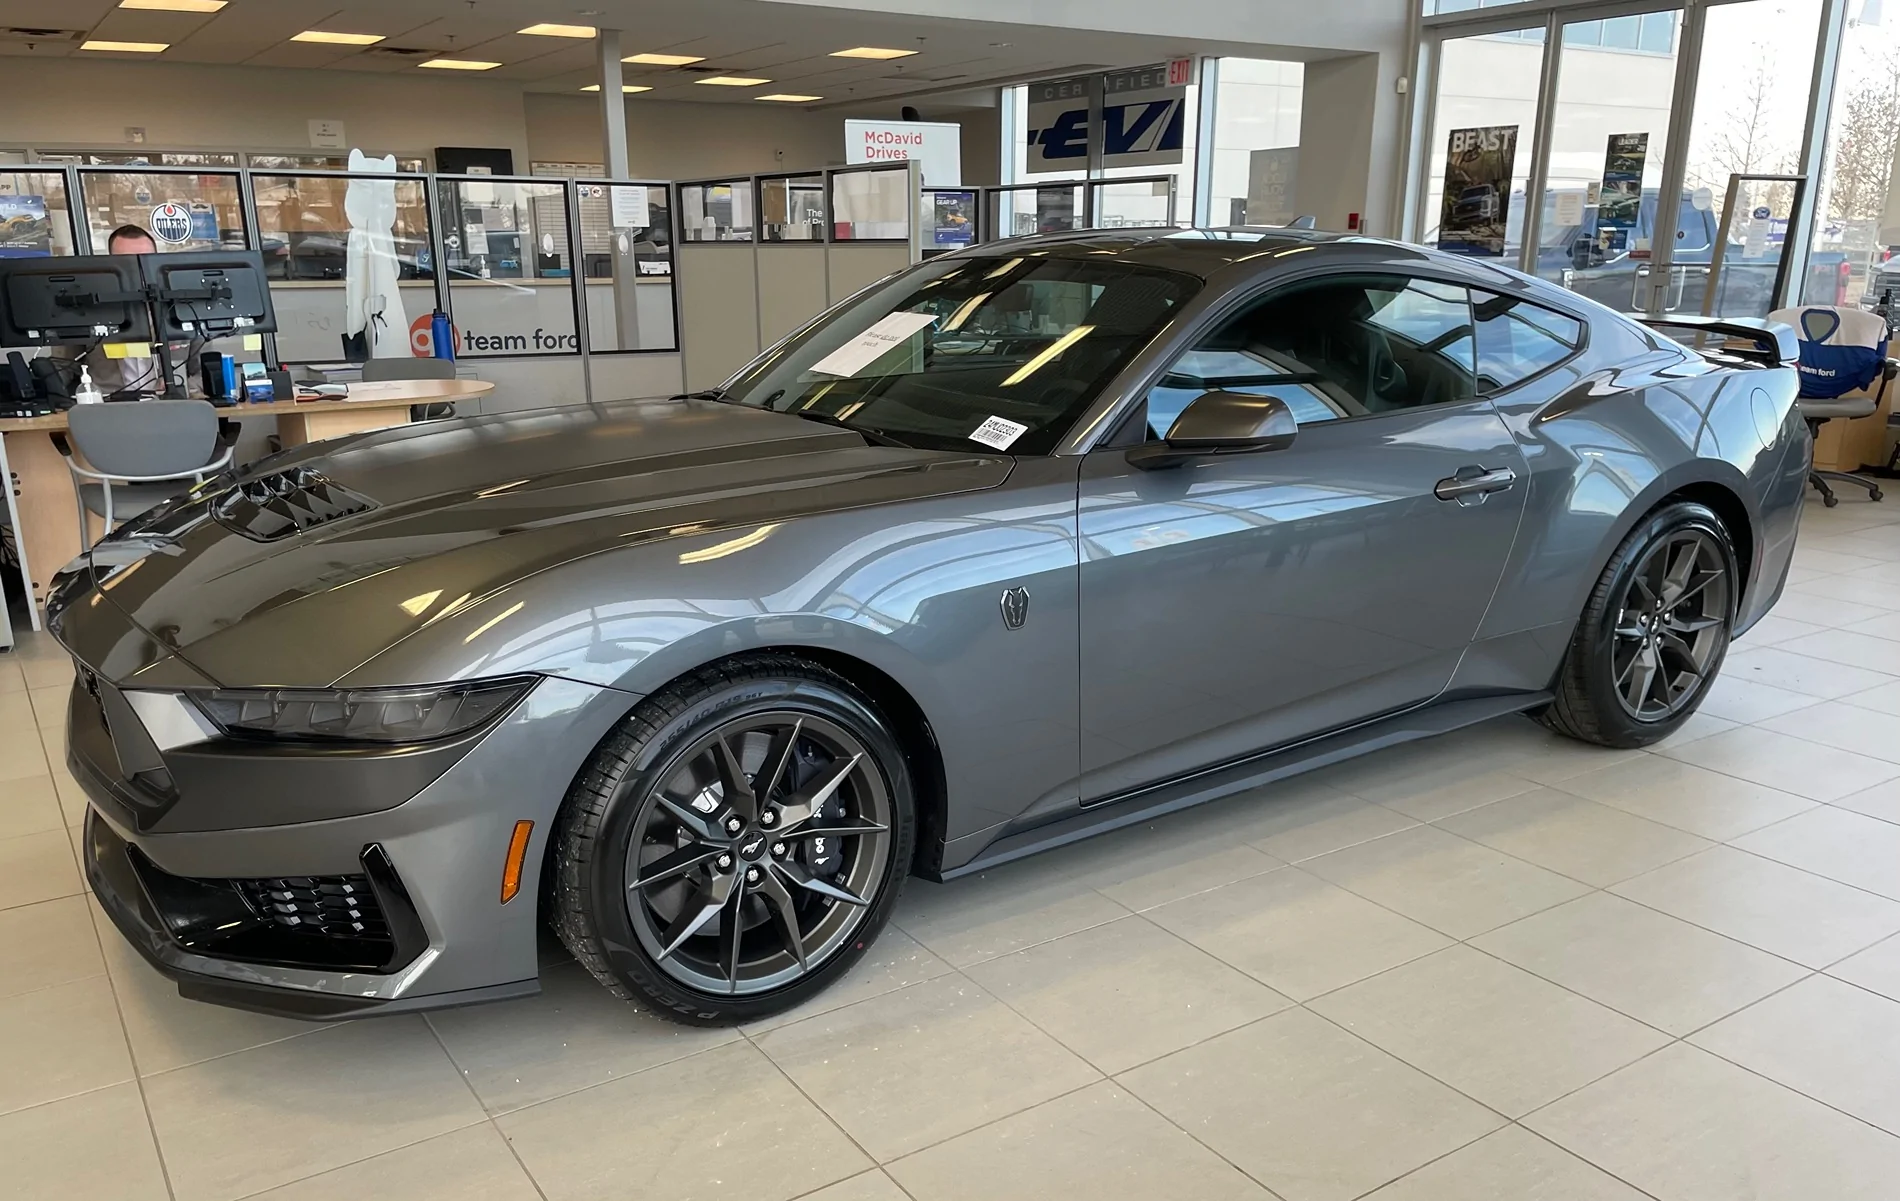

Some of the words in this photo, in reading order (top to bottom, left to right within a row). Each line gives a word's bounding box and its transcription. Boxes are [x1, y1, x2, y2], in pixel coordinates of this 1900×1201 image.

[1169, 59, 1191, 85] EXIT
[1044, 72, 1166, 100] CERIFIED
[864, 131, 923, 145] McDavid
[1451, 129, 1514, 153] BEAST
[865, 146, 908, 159] Drives
[806, 208, 823, 217] The
[156, 217, 188, 230] OILERS
[464, 330, 527, 351] team
[1800, 364, 1817, 375] eam
[1818, 368, 1836, 377] ford
